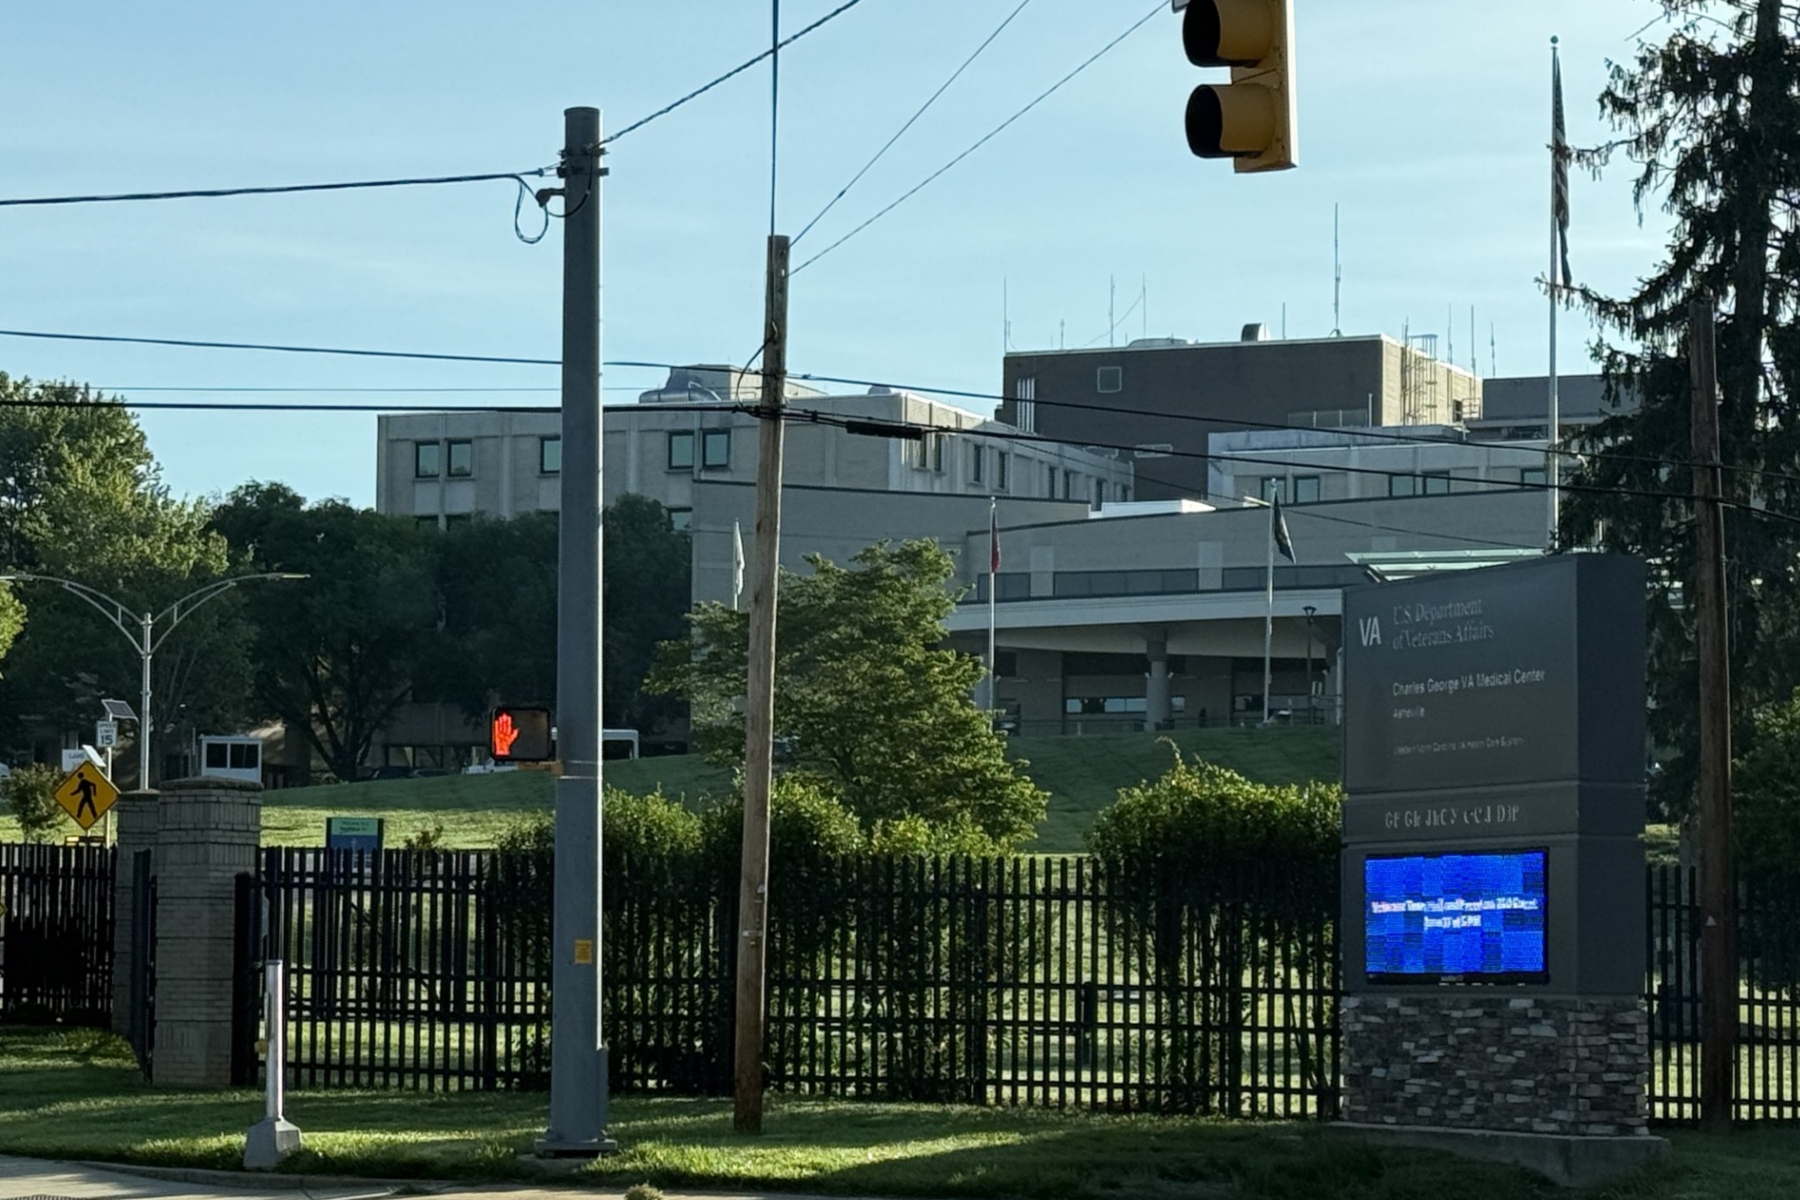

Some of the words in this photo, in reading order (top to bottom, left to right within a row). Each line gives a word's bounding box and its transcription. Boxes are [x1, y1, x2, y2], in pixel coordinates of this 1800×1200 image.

[1415, 599, 1483, 626] Department
[1358, 616, 1382, 647] VA
[1392, 634, 1404, 651] of
[1403, 628, 1452, 649] Veterans
[1453, 620, 1495, 643] Affairs
[1392, 682, 1425, 697] Charles
[1427, 677, 1459, 695] George
[1461, 674, 1475, 689] VA
[1476, 670, 1512, 687] Medical
[1513, 668, 1545, 684] Center
[101, 734, 113, 745] 15
